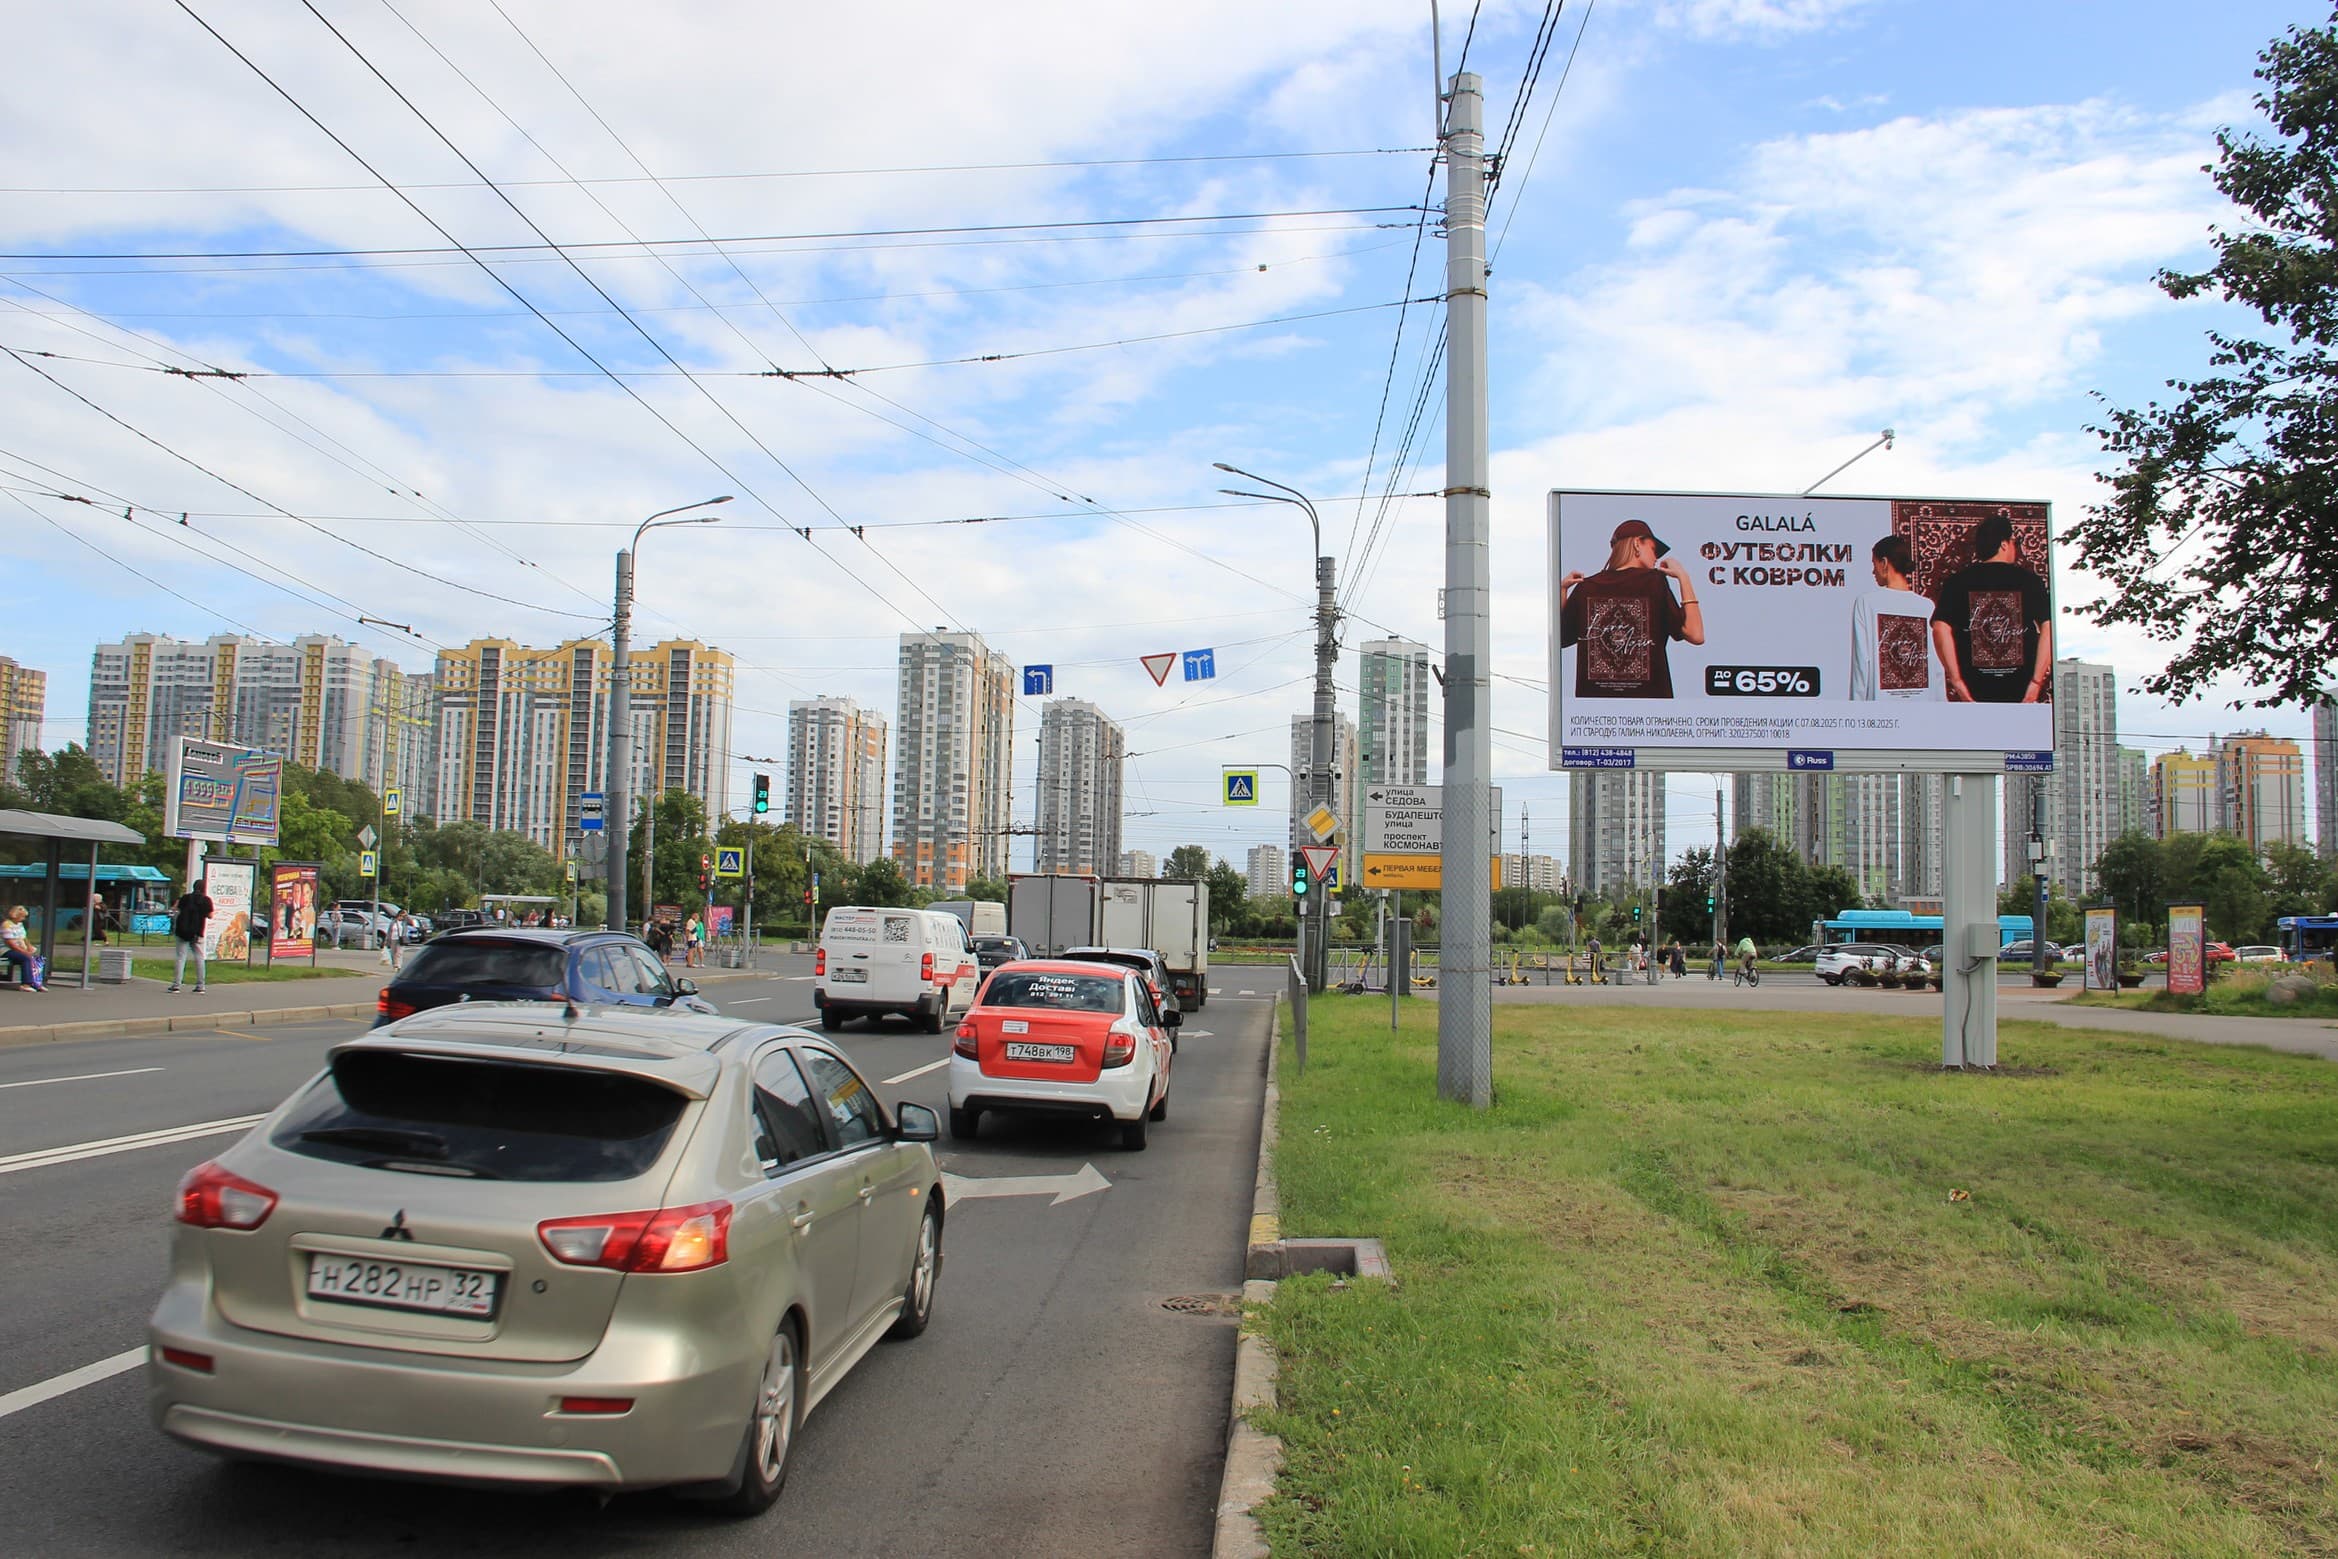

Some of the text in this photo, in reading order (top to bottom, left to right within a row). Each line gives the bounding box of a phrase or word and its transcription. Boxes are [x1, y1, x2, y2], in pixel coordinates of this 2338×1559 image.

[1736, 512, 1816, 532] GALALÁ
[1700, 542, 1852, 562] ФУТБОЛКИ
[1709, 566, 1845, 586] С КОВРОМ
[1714, 670, 1732, 680] до
[1570, 716, 1617, 726] КОЛИЧЕСТВО
[1618, 716, 1644, 726] ТОВАРА
[1646, 716, 1693, 726] ОГРАНИЧЕНО.
[1696, 717, 1720, 727] СРОКИ
[1720, 718, 1767, 728] ПРОВЕДЕНИЯ
[1768, 718, 1792, 729] АКЦИИ
[1794, 718, 1800, 728] С
[1800, 718, 1837, 728] 07.08.2025
[1845, 719, 1856, 728] ПО
[1858, 719, 1894, 729] 13.08.2025
[1570, 728, 1790, 739] ИП СТАРОДУБ ГАЛИНА НИКОЛАЕВНА, ОГРНИП: 320237500110018
[1582, 749, 1599, 757] (812)
[1564, 759, 1595, 767] договор:
[1806, 756, 1828, 764] Russ
[1386, 797, 1426, 806] СЕДОВА
[1384, 833, 1427, 841] проспект
[1011, 1045, 1071, 1056] Т748ВК 198
[322, 1262, 482, 1302] Н282НР 32
